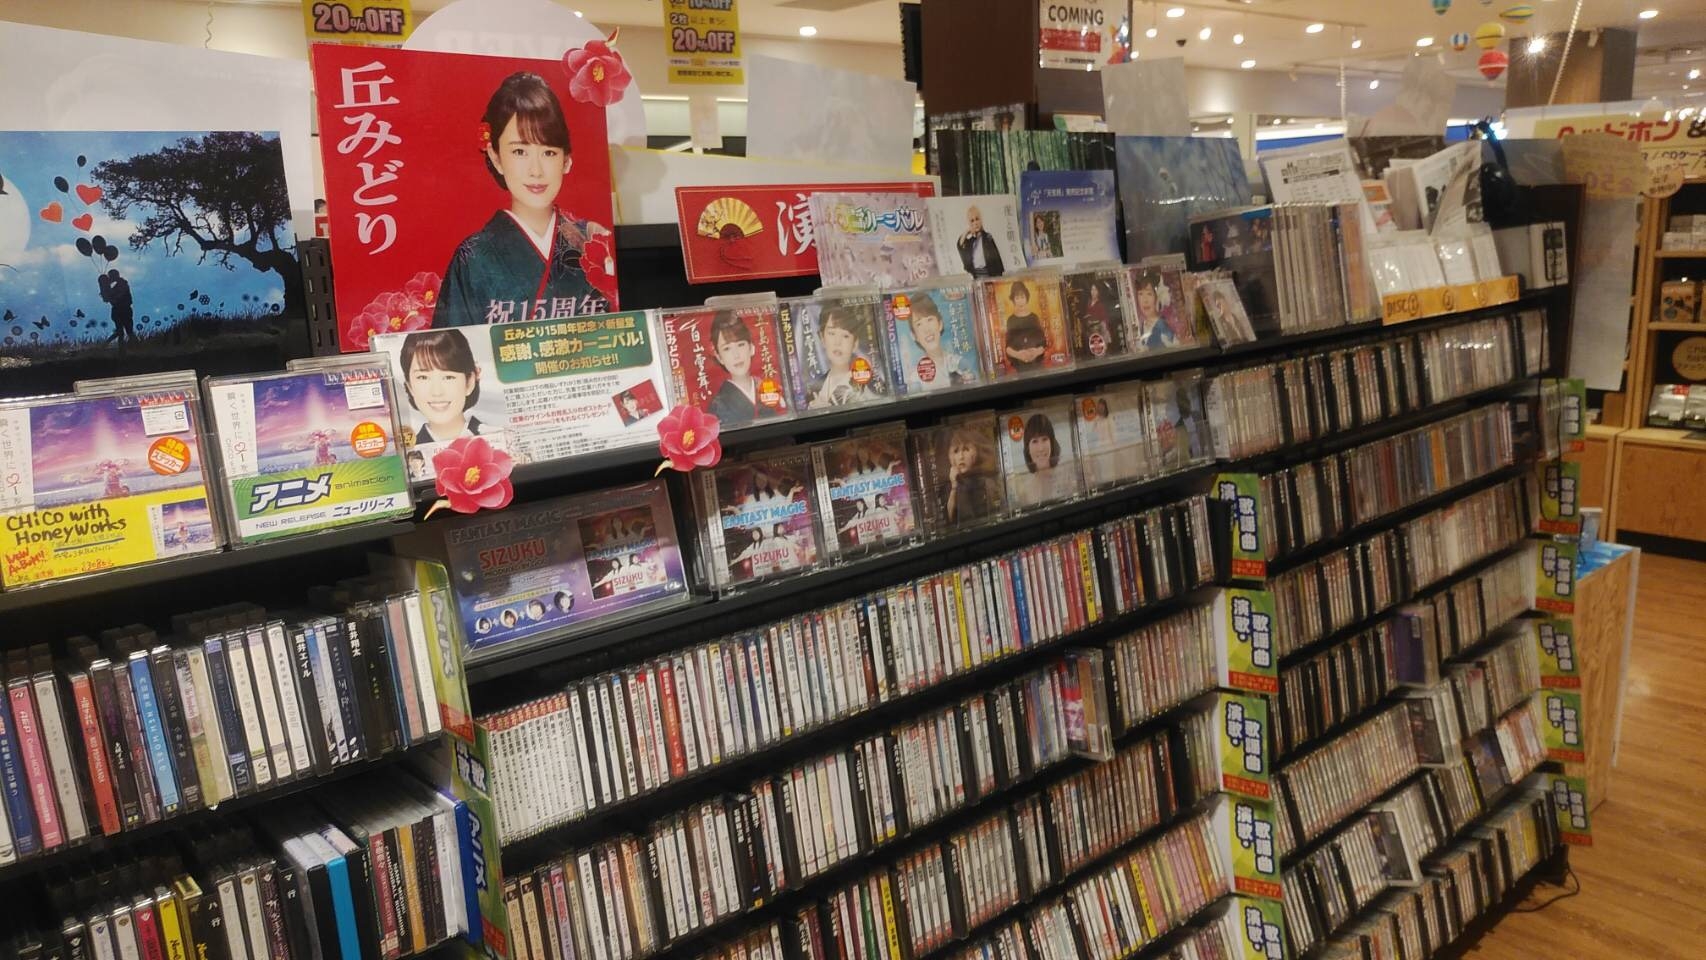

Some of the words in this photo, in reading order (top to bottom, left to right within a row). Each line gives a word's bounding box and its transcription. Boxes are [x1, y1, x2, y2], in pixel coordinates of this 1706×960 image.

[312, 3, 404, 35] 20%OFF
[1048, 5, 1104, 25] COMING
[672, 28, 735, 53] 20%OFF
[333, 61, 404, 255] 丘みどり
[504, 317, 635, 341] 丘みどり15周年記念×新星堂
[780, 311, 795, 356] 丘みどり
[664, 319, 681, 370] 丘みどり
[535, 354, 619, 375] 開催のお知らせ!!
[252, 474, 333, 513] アニメ
[335, 475, 395, 490] animation
[831, 482, 870, 499] FANTASY
[70, 503, 110, 522] with
[332, 497, 395, 518] ニューリリース
[724, 509, 768, 529] FANTASY
[256, 520, 278, 529] NEW
[281, 511, 328, 525] RELEASE
[451, 520, 513, 544] FANTASY
[859, 517, 890, 534] SIZUKU
[478, 538, 547, 570] SIZUKU
[754, 547, 789, 564] SIZUKU
[613, 571, 644, 587] SIZUKU
[348, 621, 362, 658] 蒼井翔太
[295, 634, 312, 678] 藍井エイル
